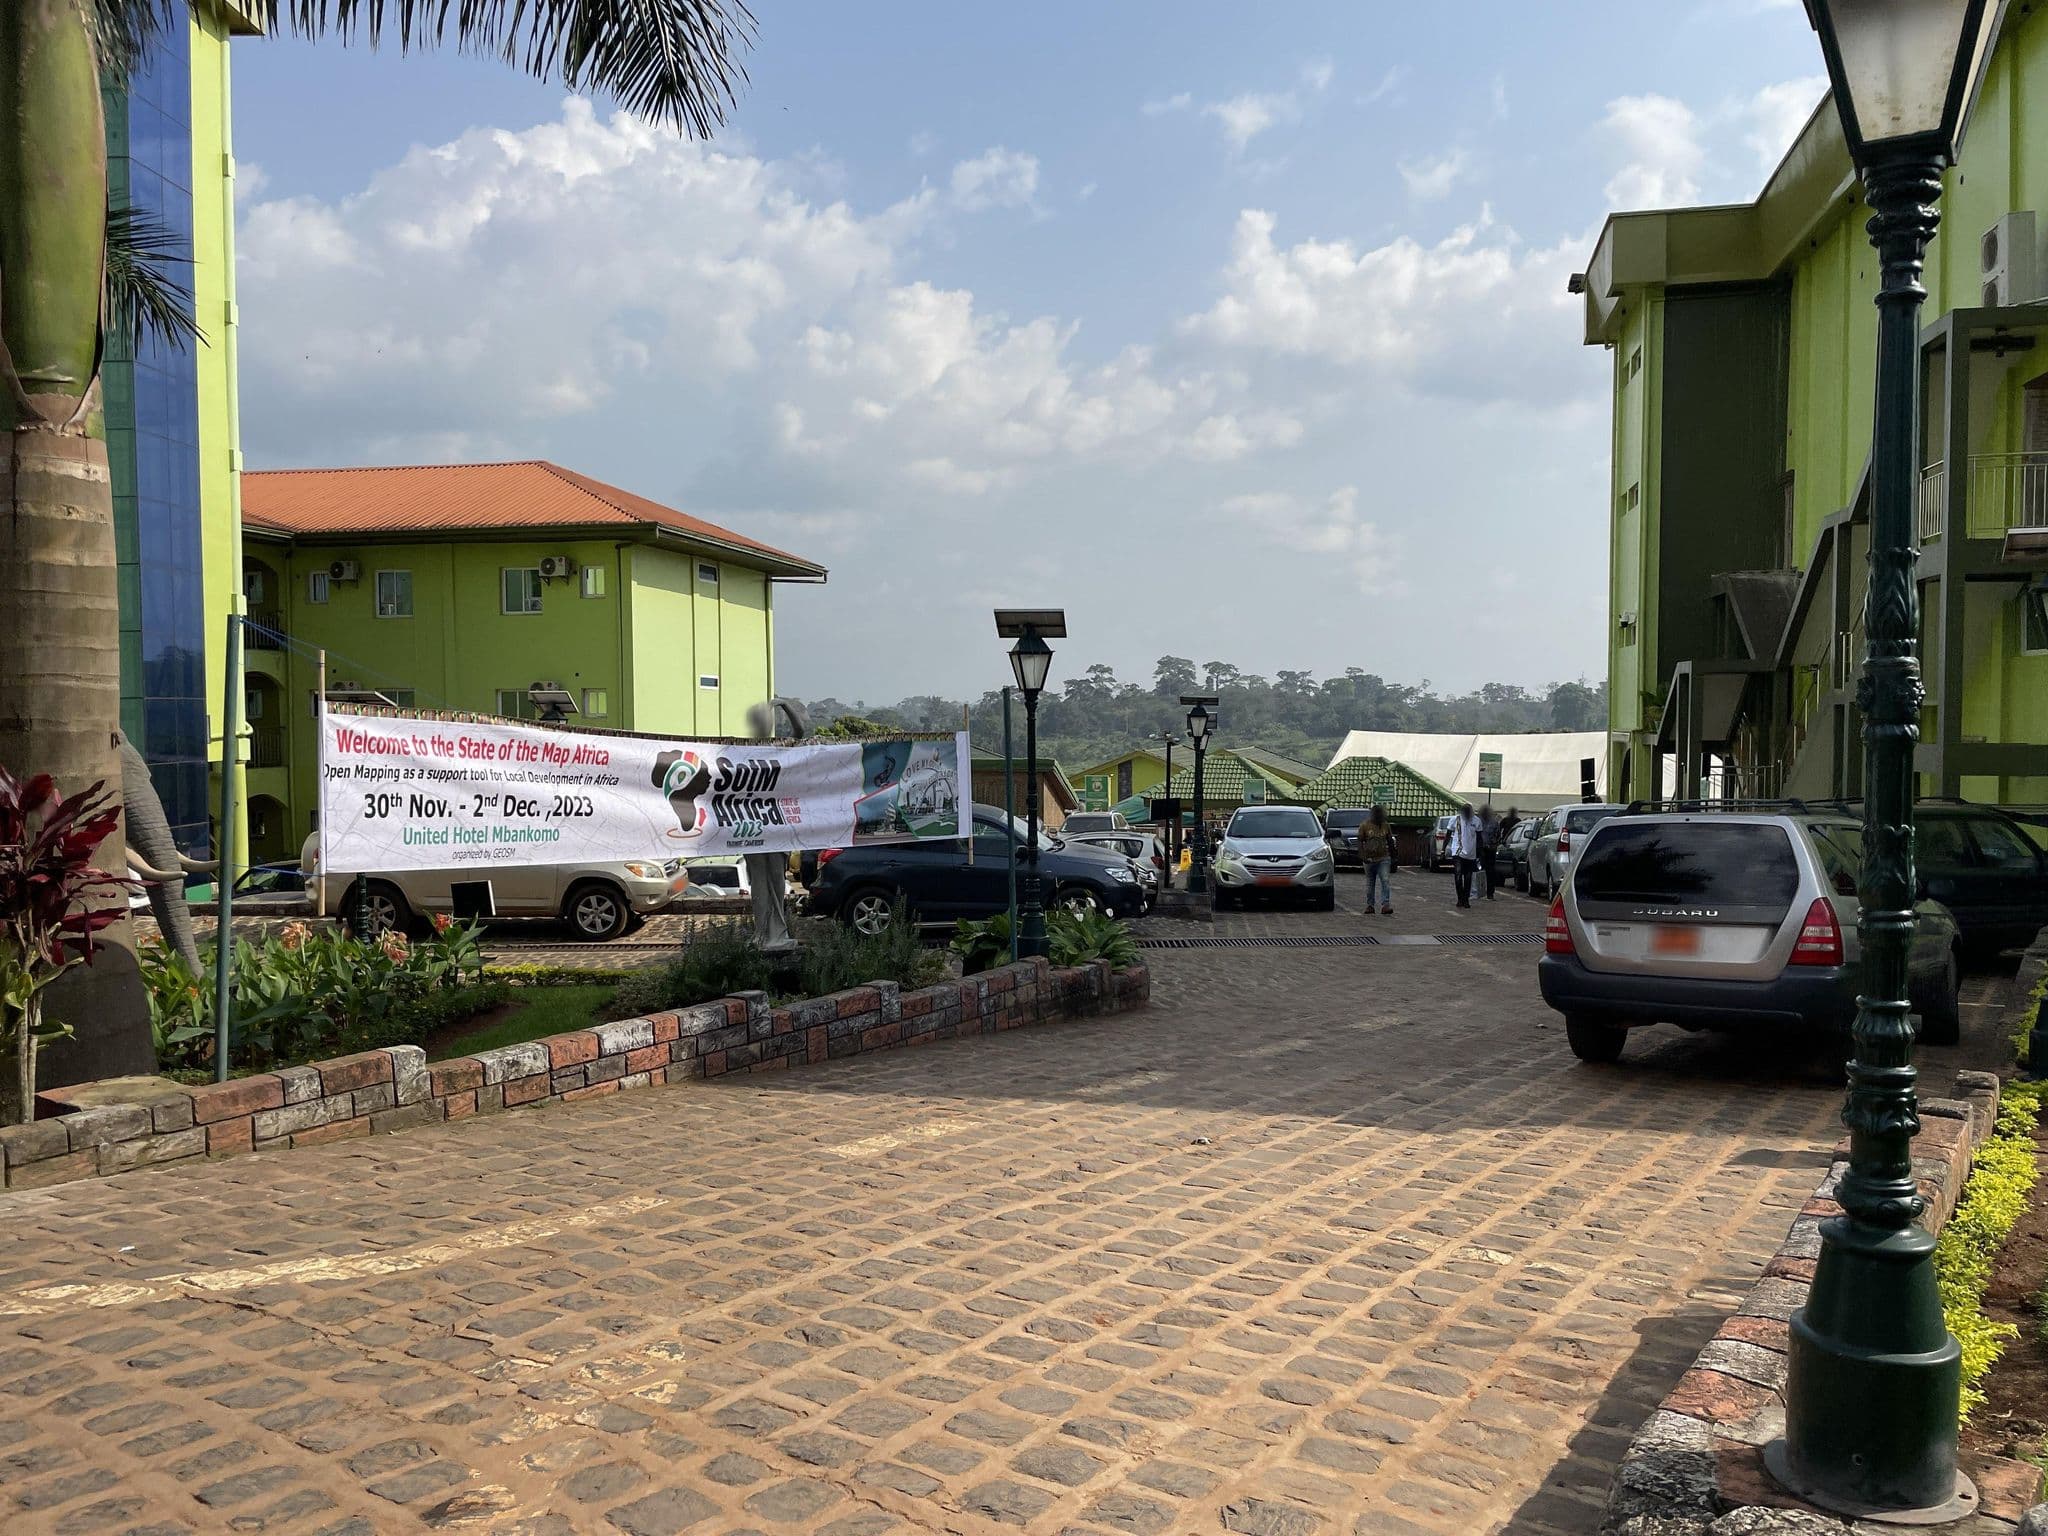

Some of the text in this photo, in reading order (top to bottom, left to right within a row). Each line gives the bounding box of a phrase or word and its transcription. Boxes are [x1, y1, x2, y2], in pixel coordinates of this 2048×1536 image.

[336, 729, 609, 768] Welcome to the State of the Map Africa
[354, 764, 401, 782] Mapping
[403, 767, 415, 779] as
[418, 769, 424, 779] a
[427, 767, 468, 783] support
[471, 768, 488, 781] tool
[490, 769, 502, 781] for
[504, 770, 526, 782] Local
[528, 771, 582, 787] Development
[584, 773, 593, 785] in
[594, 773, 619, 786] Africa
[364, 793, 403, 818] 30th
[409, 794, 452, 818] Nov.
[473, 794, 498, 818] 2nd
[504, 795, 540, 817] Dec.
[712, 792, 784, 827] Africa
[403, 825, 560, 845] United Hotel Mbankomo
[733, 821, 763, 838] 2023
